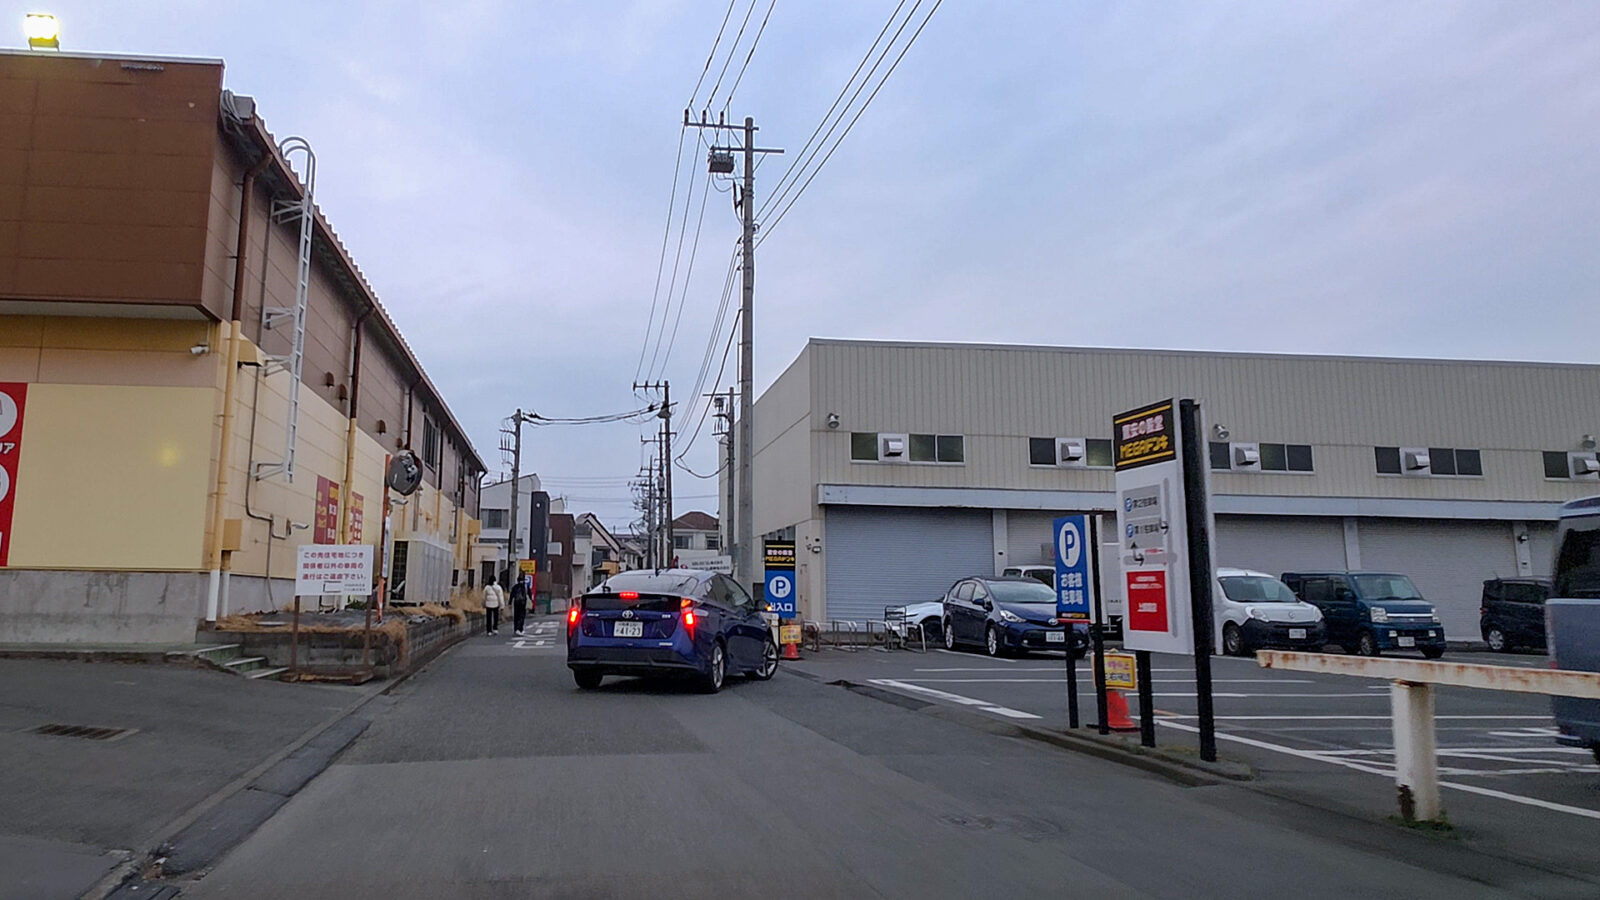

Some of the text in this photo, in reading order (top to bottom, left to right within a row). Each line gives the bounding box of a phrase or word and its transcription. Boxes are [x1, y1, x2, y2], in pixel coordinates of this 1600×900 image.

[1064, 530, 1075, 560] P
[303, 551, 364, 559] この先住宅地につき
[775, 579, 786, 595] P
[1060, 572, 1083, 588] お客様
[1061, 589, 1084, 605] 駐車場
